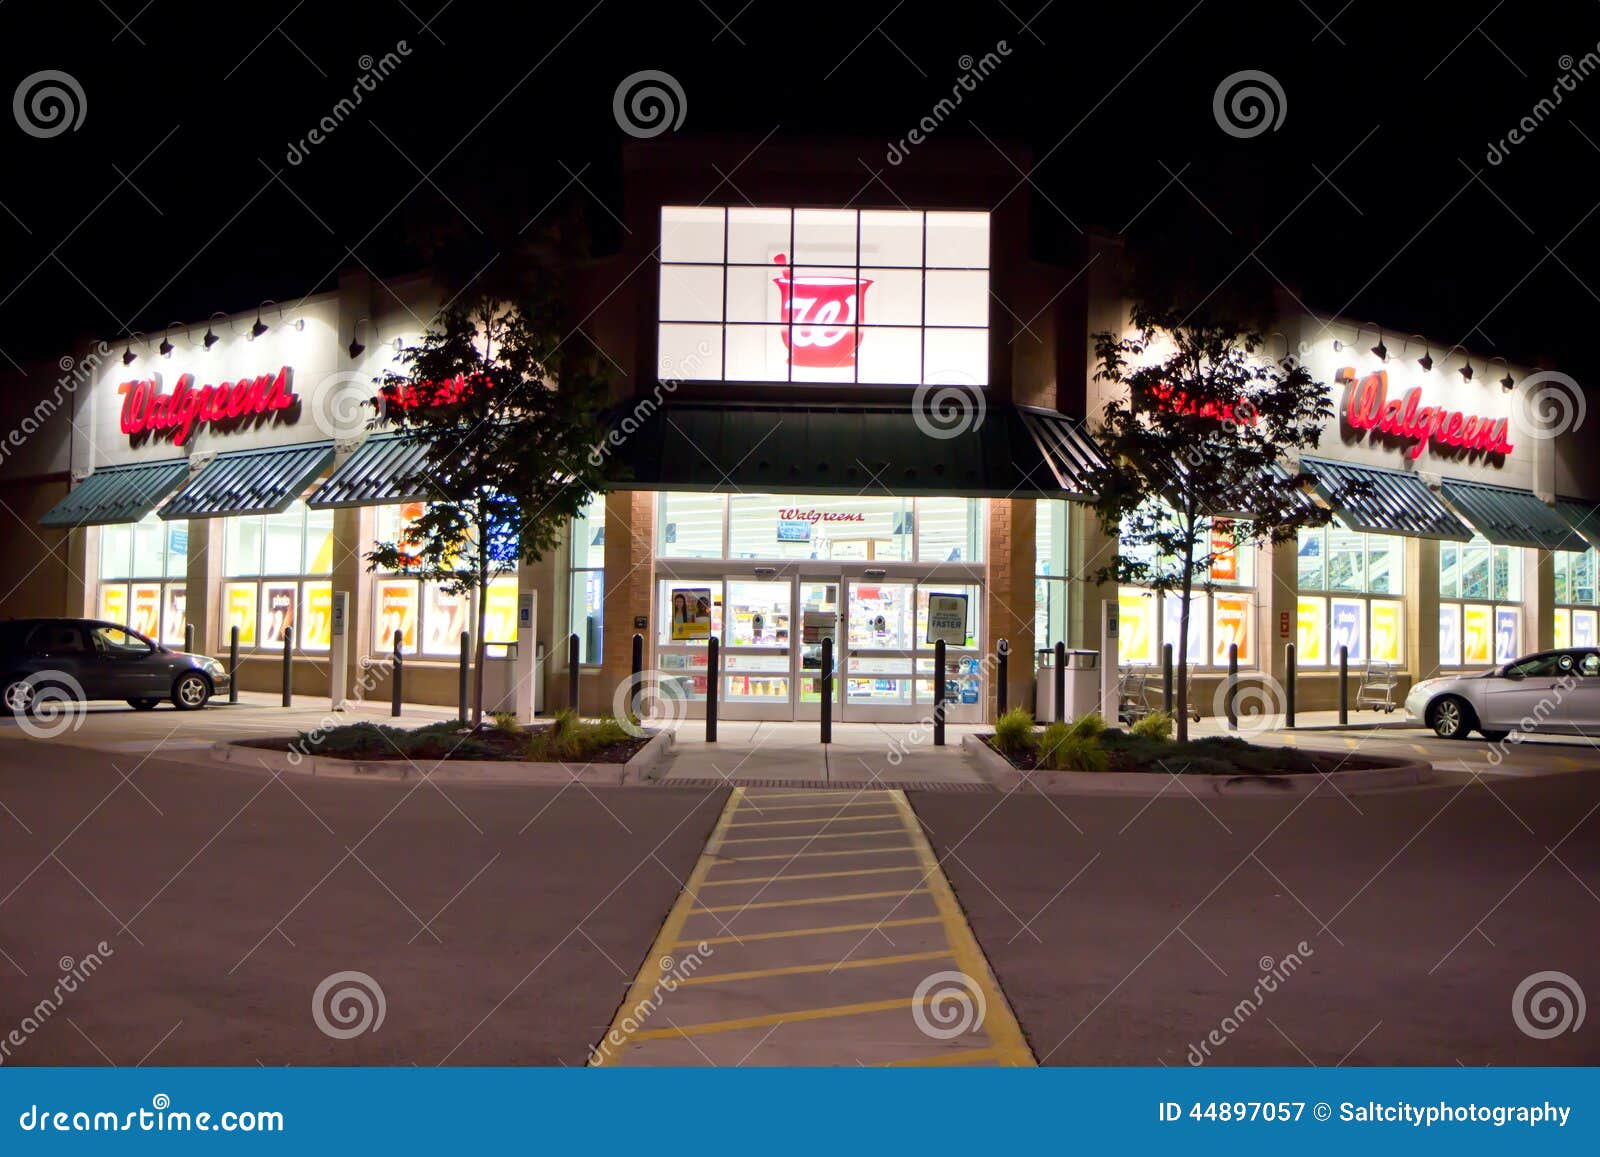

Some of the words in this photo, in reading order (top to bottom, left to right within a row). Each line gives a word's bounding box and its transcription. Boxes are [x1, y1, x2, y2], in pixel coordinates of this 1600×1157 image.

[118, 366, 293, 446] Walgreens
[1343, 366, 1514, 460] Walgreens
[778, 508, 865, 525] Walgreens
[932, 620, 961, 629] FASTER
